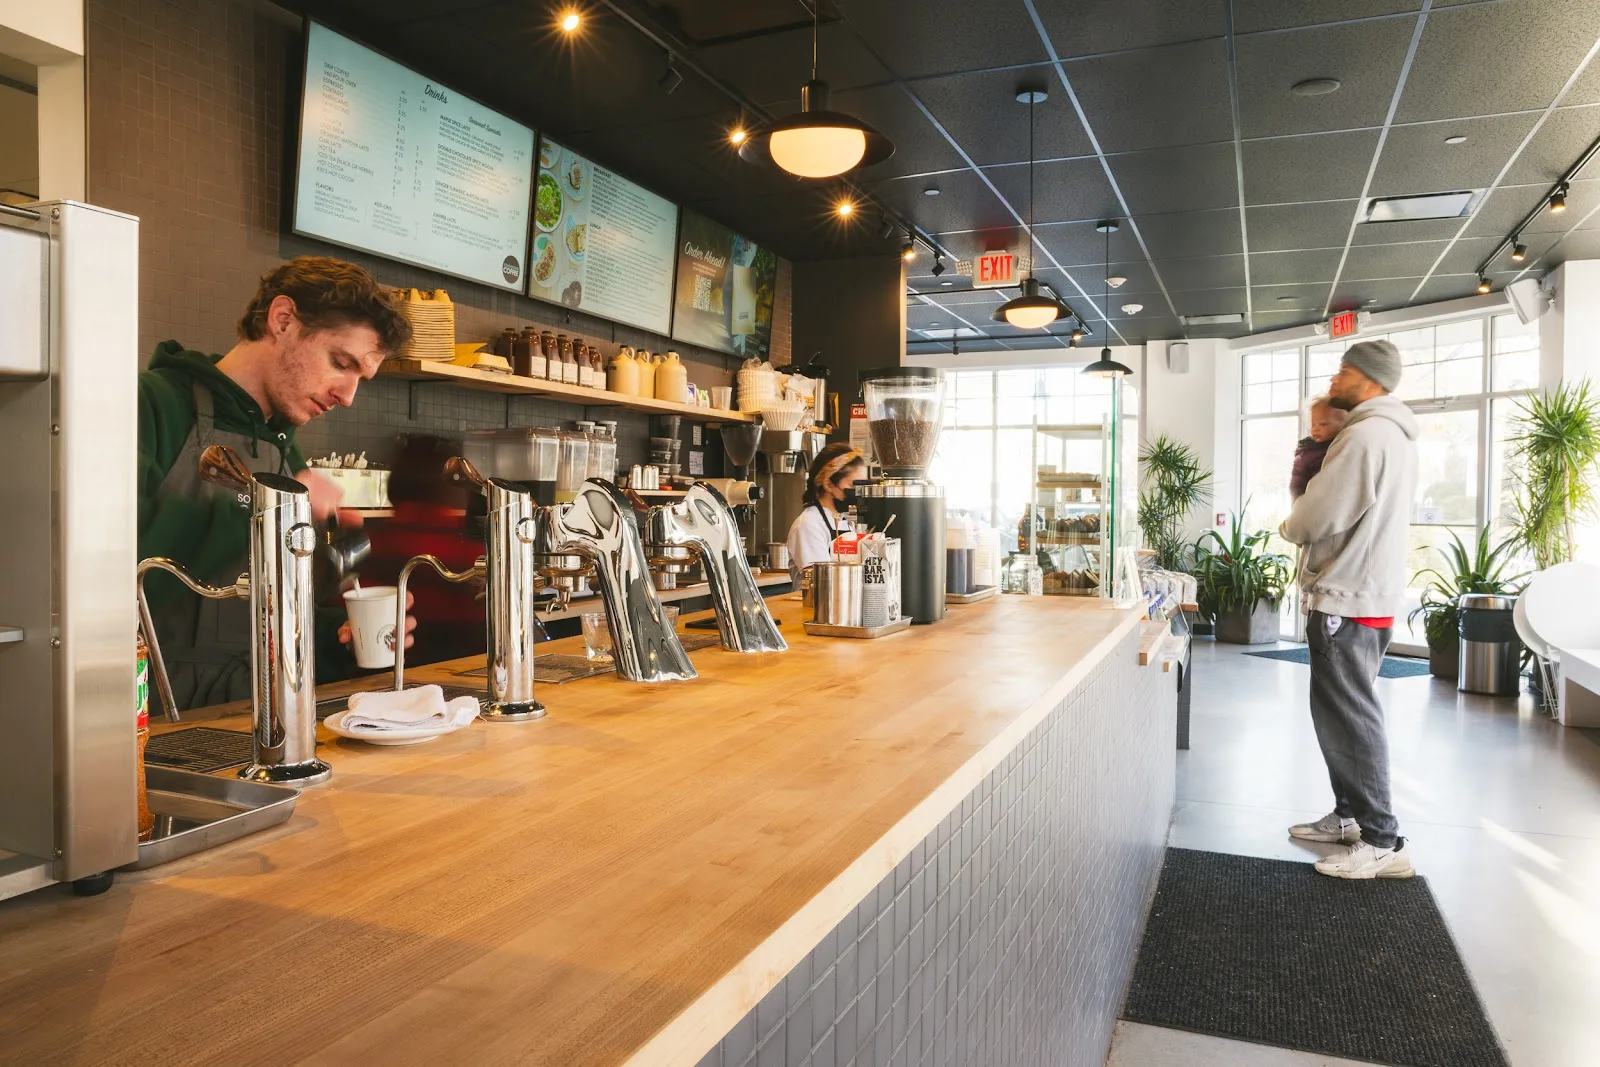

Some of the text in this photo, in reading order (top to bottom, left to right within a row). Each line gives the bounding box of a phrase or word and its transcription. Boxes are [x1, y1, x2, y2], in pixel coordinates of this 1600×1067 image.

[333, 66, 349, 77] COFFEE
[424, 84, 448, 104] Drinks
[594, 167, 612, 178] BREAKFAST
[684, 242, 726, 268] Order Ahead!
[503, 267, 519, 277] COFFEE
[980, 256, 1012, 282] EXIT
[1334, 314, 1354, 336] EXIT
[852, 408, 868, 416] CHO
[238, 494, 251, 504] SO
[865, 556, 884, 566] HEY
[864, 565, 885, 574] BAR-
[864, 575, 885, 584] ISTA
